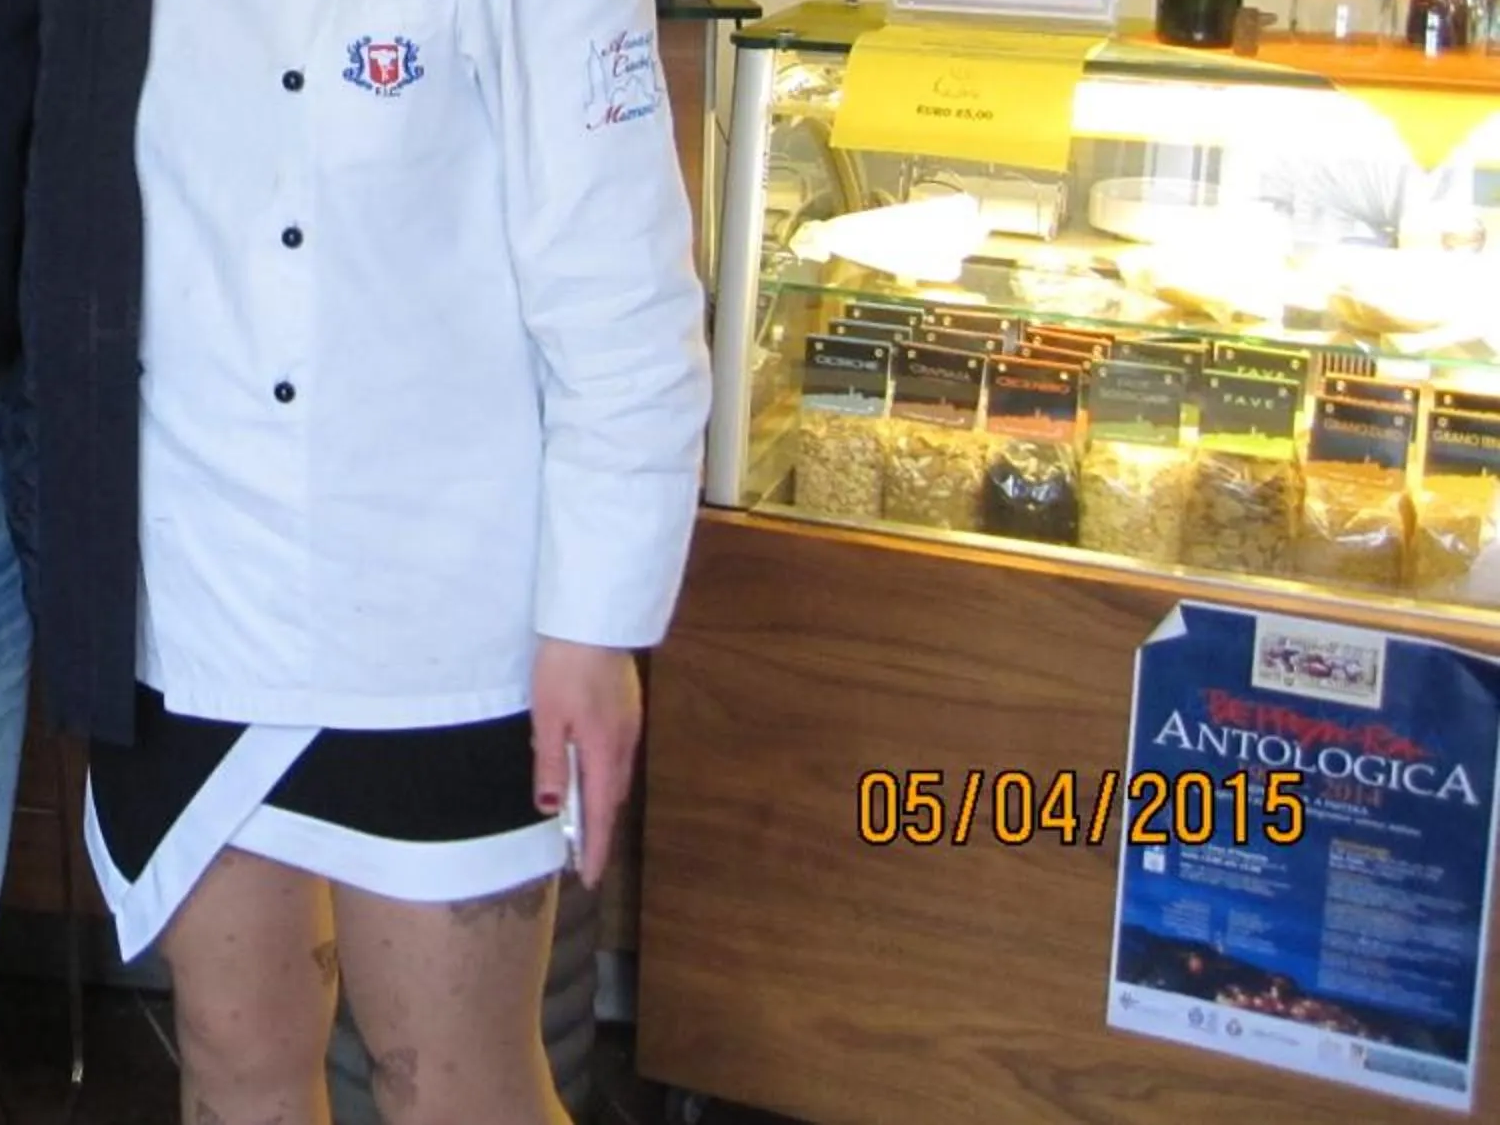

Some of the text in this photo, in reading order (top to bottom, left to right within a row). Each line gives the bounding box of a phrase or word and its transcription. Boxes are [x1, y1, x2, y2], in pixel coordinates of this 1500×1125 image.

[916, 104, 952, 117] EURO
[1222, 393, 1276, 410] FAVE
[1153, 708, 1481, 806] ANTOLOGICA
